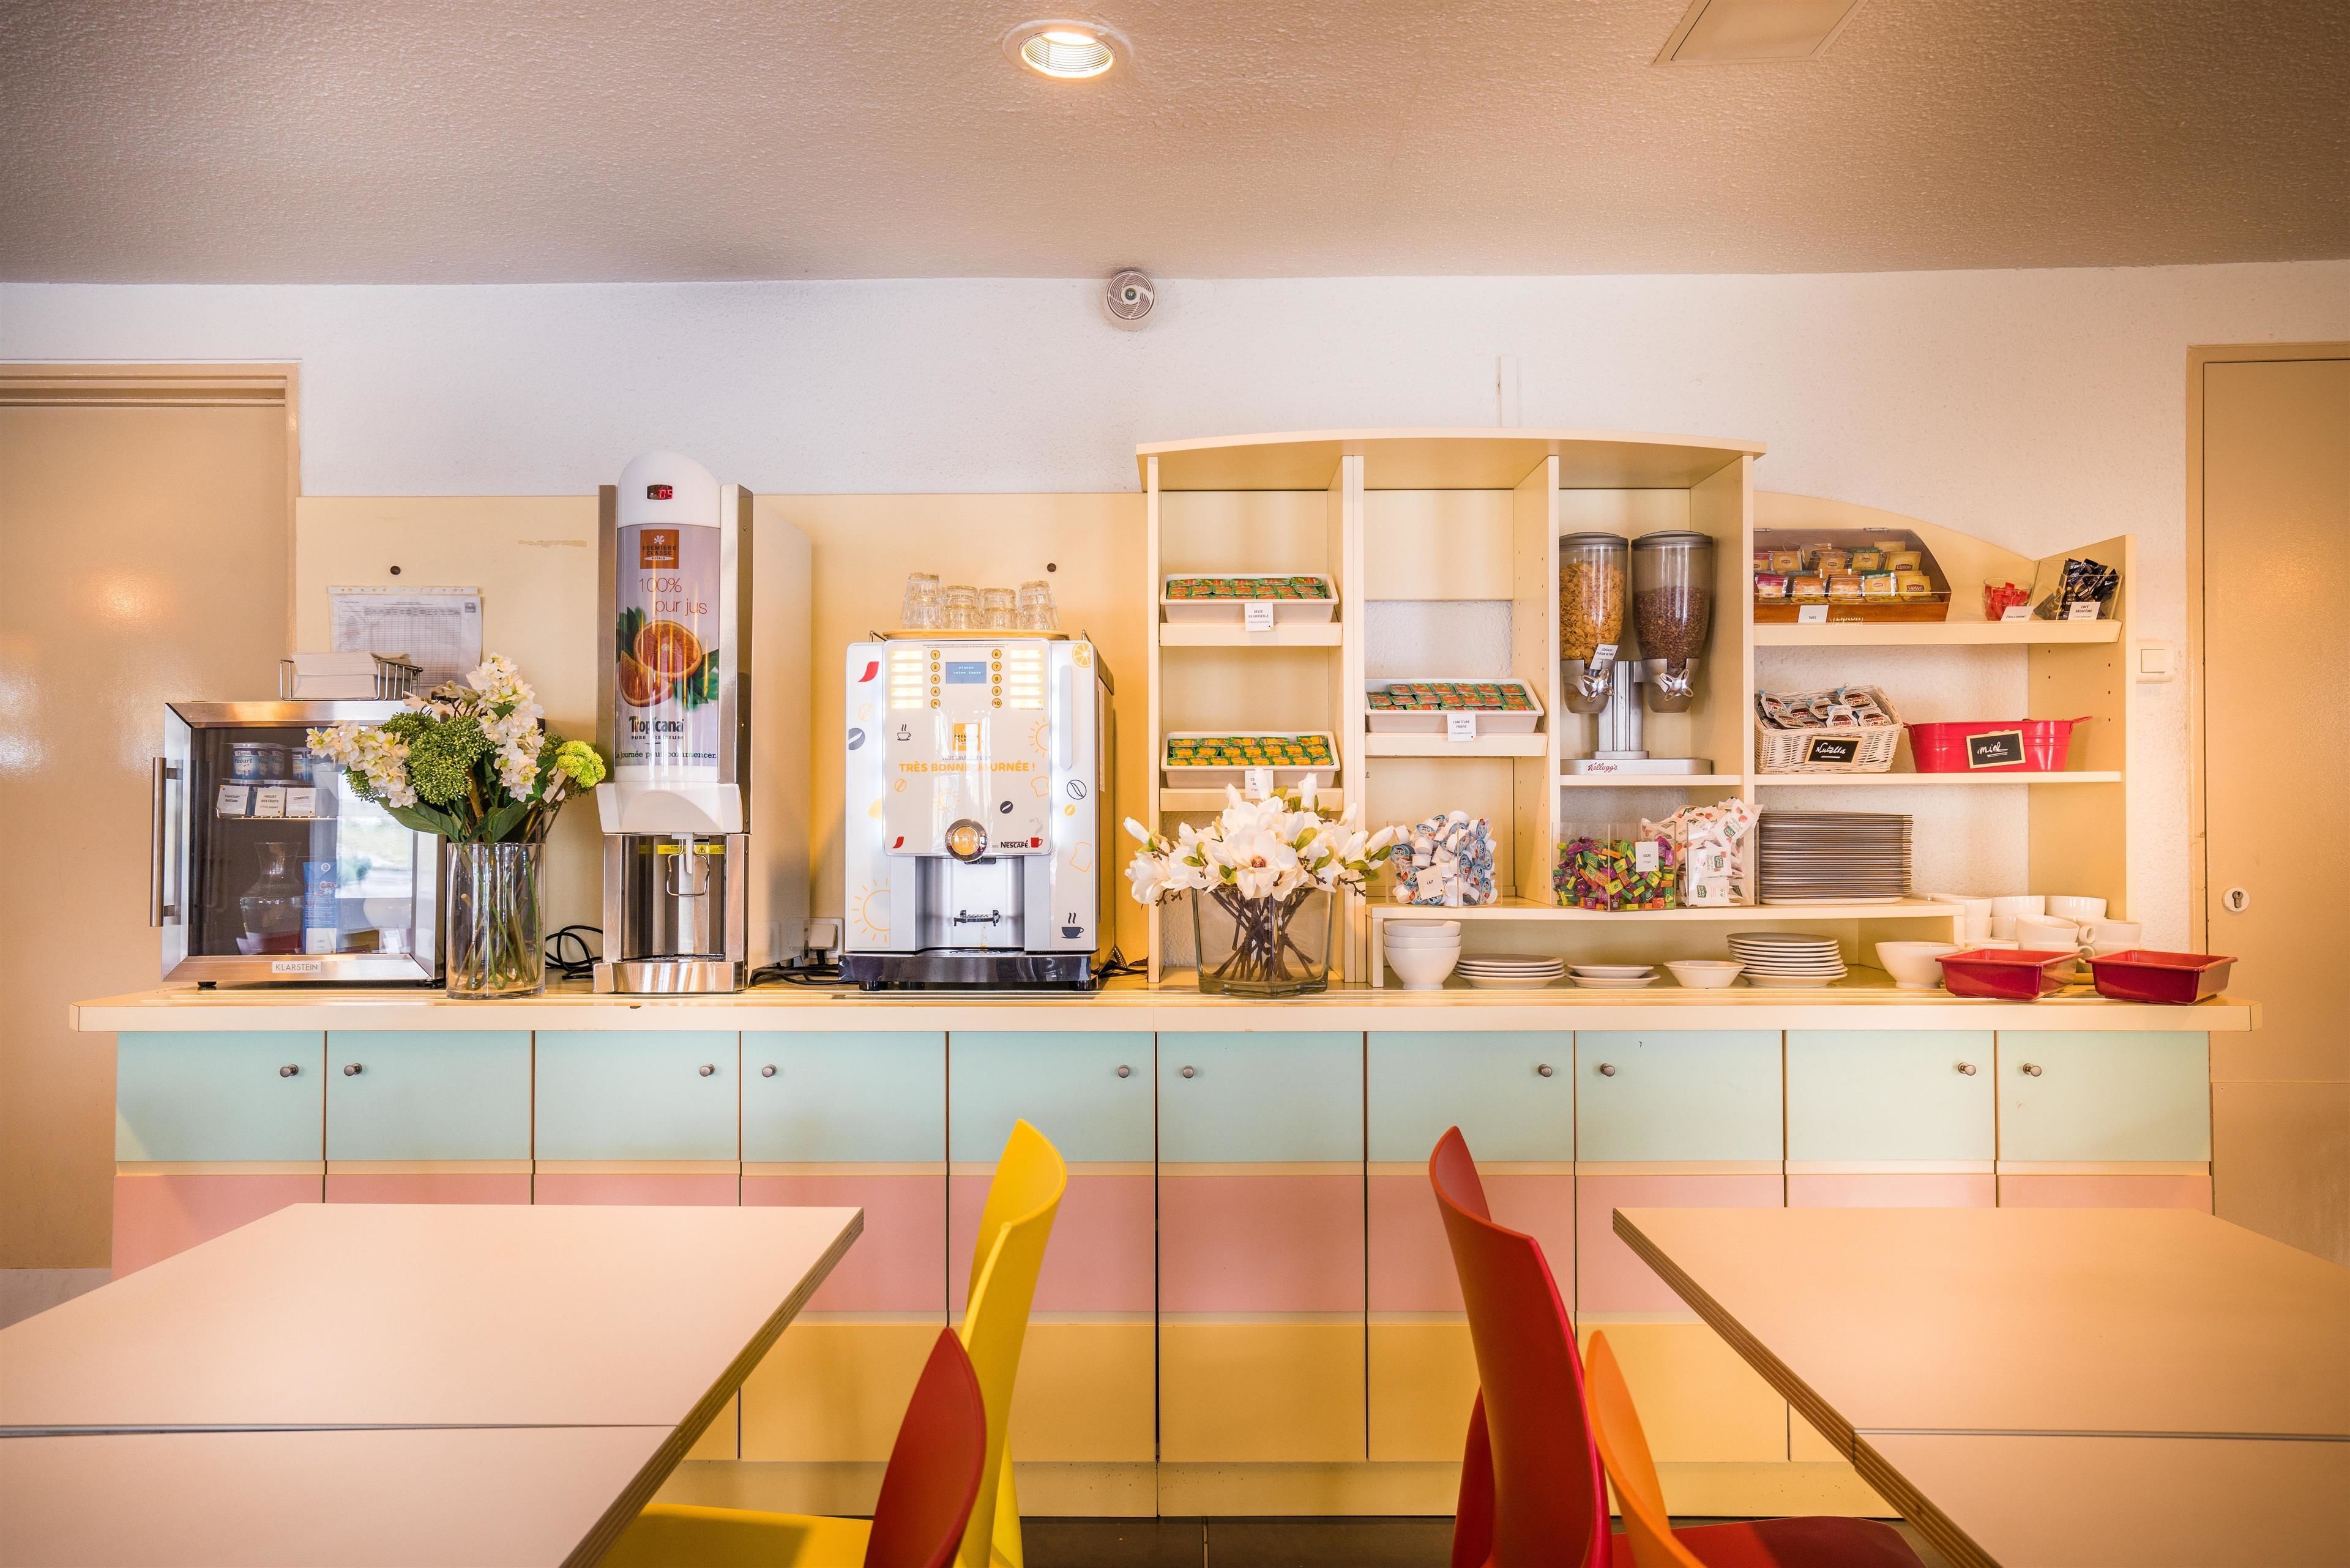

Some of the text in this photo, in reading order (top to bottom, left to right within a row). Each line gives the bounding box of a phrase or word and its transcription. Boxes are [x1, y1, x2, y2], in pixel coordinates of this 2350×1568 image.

[639, 577, 682, 593] 100%
[655, 598, 707, 616] pur jus
[620, 751, 643, 760] journée
[899, 760, 928, 772] TRÈS
[1587, 762, 1618, 773] Kellogg's
[1001, 840, 1029, 848] NESCAFÉ
